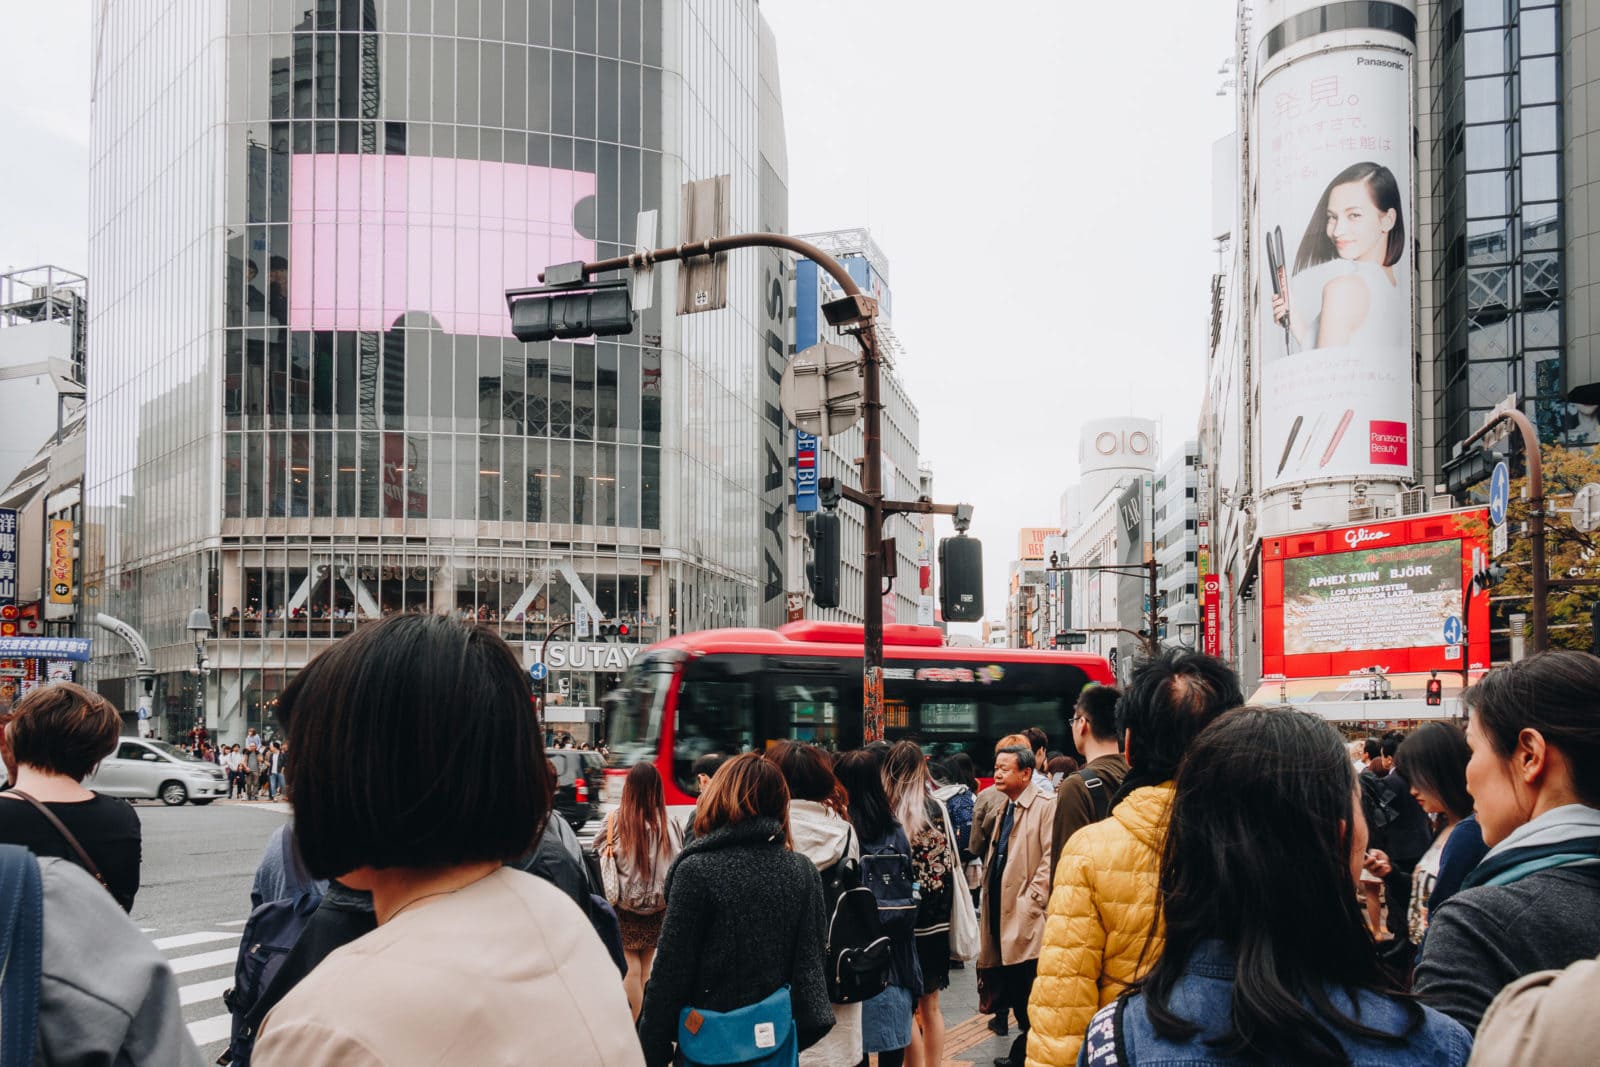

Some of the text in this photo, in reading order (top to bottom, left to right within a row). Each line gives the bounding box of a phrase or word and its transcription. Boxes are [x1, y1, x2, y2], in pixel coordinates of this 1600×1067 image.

[1357, 57, 1404, 70] Panasonic
[1371, 432, 1406, 444] Panasonic
[1371, 443, 1398, 455] Beauty
[1121, 497, 1141, 531] ZAR
[1032, 530, 1061, 542] TOW
[1345, 528, 1390, 548] Glico
[317, 564, 440, 580] STARBUCK
[1309, 565, 1432, 587] APHEX TWIN BJÖRK
[1330, 583, 1408, 597] LCD SOUNDSYSTEM
[1358, 593, 1386, 602] MAJOR
